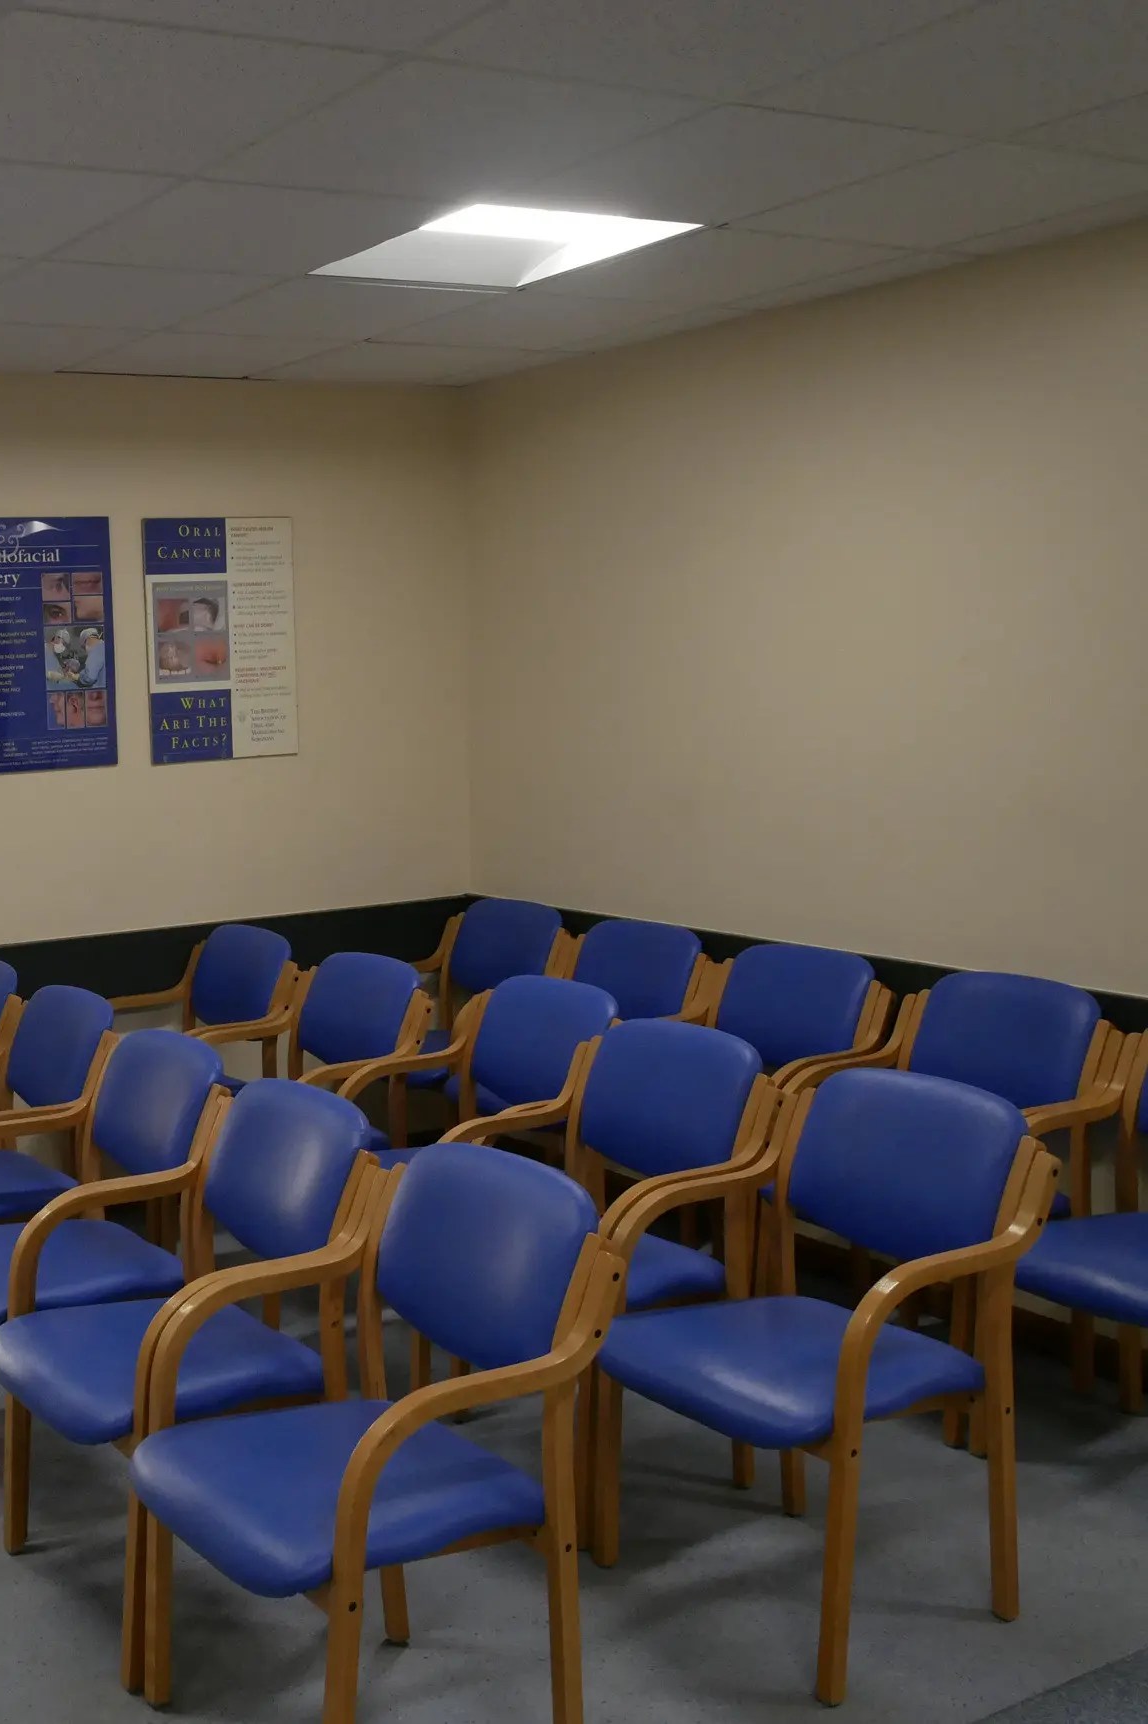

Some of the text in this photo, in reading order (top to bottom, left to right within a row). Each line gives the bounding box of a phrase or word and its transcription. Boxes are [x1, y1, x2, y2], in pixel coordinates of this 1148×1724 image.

[178, 524, 221, 537] ORAL
[157, 546, 221, 559] CANCER
[180, 697, 226, 710] WHAT
[160, 715, 227, 731] ARE THE
[172, 733, 227, 749] FACTS?
